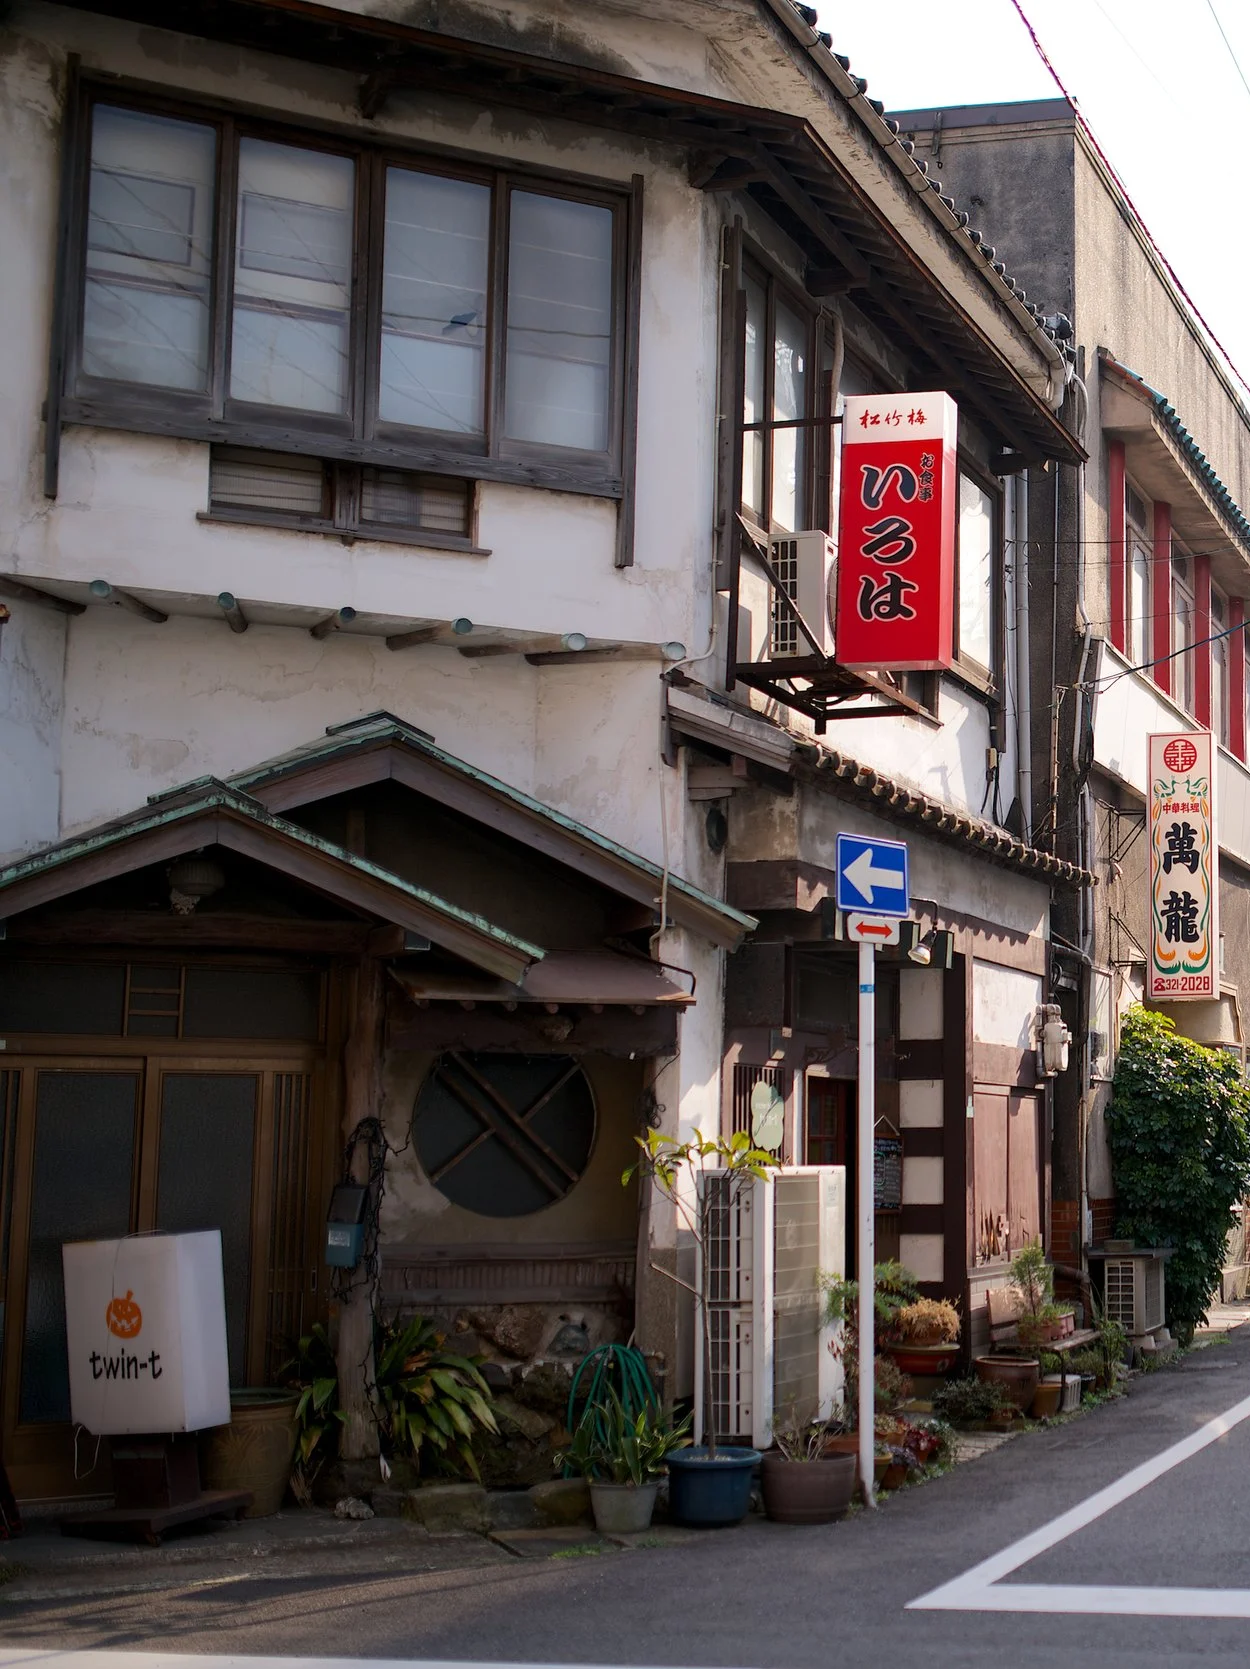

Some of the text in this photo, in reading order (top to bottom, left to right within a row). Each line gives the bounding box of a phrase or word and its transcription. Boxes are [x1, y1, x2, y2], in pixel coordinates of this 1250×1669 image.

[859, 408, 928, 429] 松竹梅
[918, 453, 934, 502] お食事
[857, 464, 920, 622] いろは
[1162, 802, 1200, 814] 中華料理
[1161, 822, 1200, 944] 萬龍
[1165, 976, 1210, 991] 321-2028
[89, 1348, 162, 1380] twin-t
